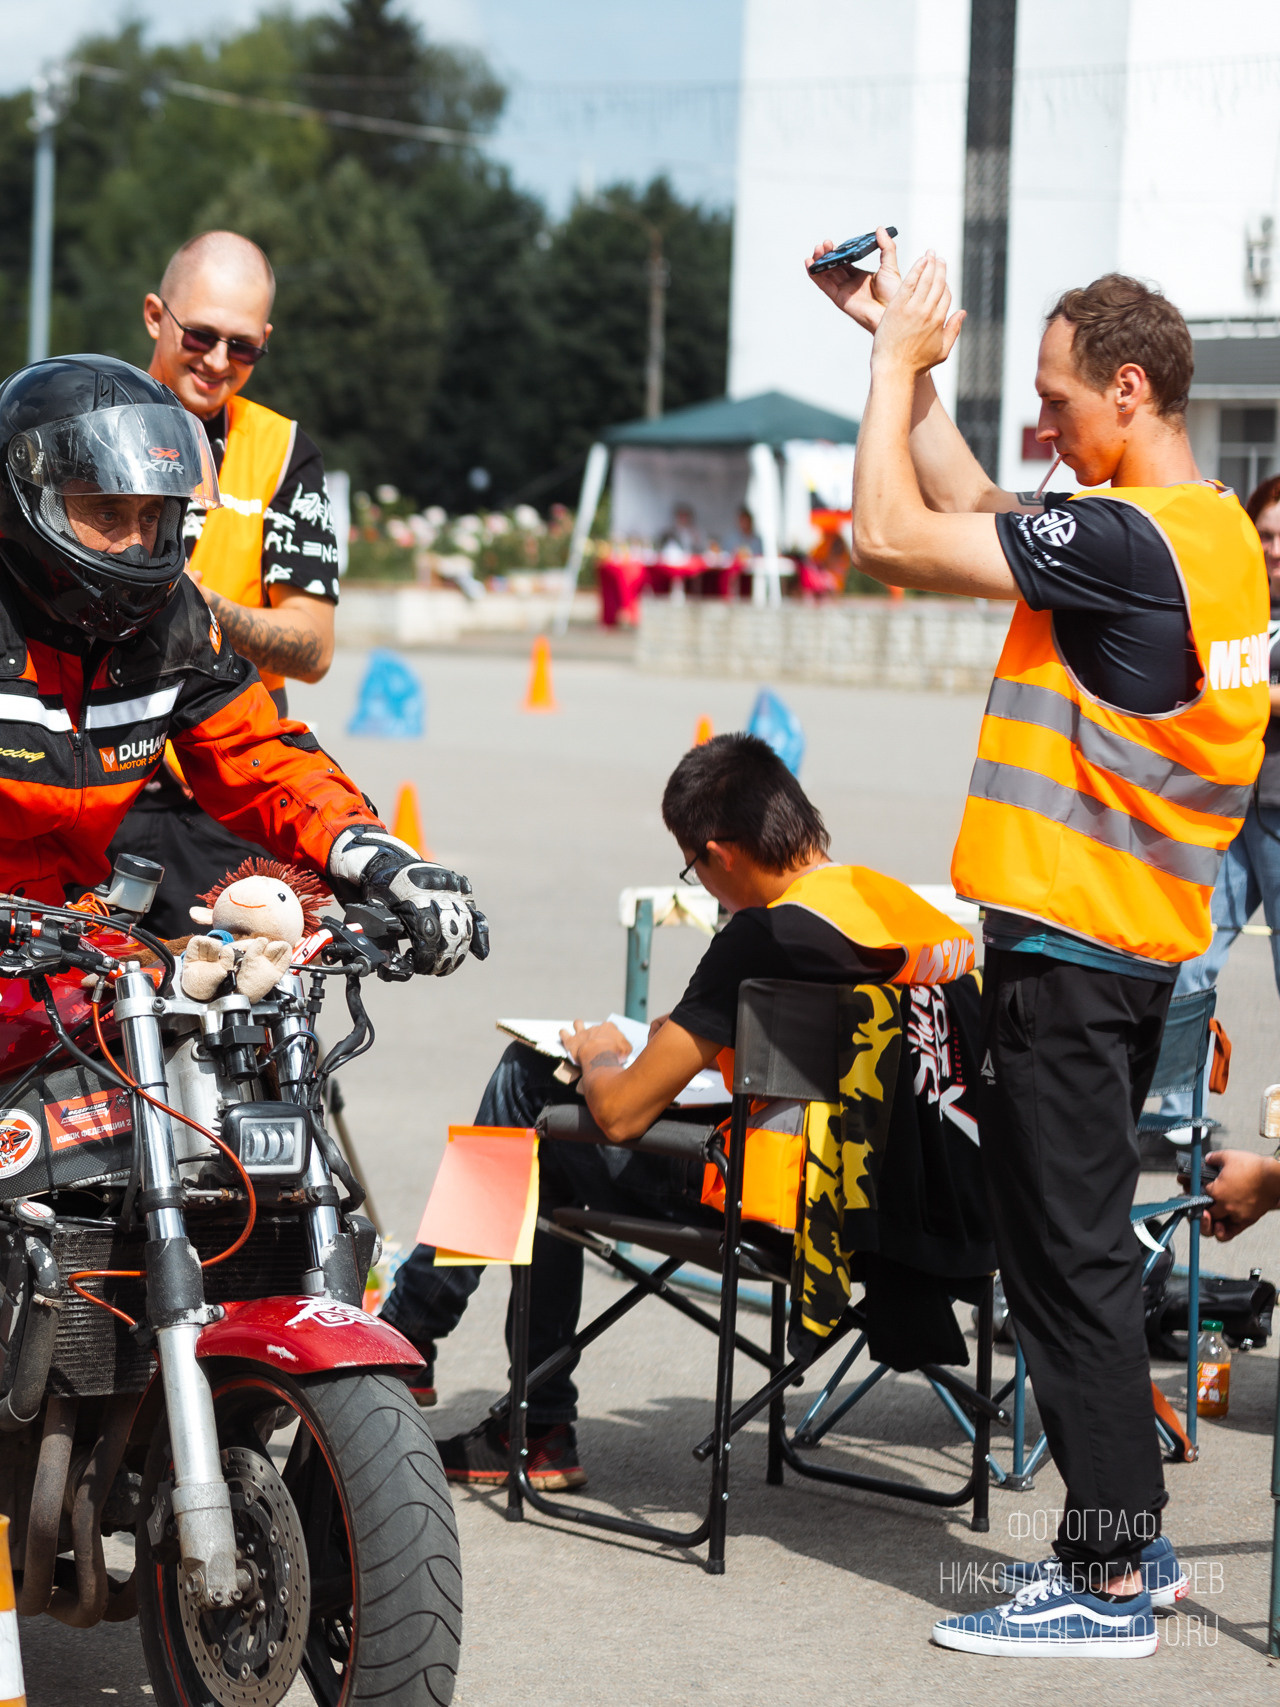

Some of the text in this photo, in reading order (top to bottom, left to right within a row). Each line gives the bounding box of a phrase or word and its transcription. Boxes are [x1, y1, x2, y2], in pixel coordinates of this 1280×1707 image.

[119, 730, 168, 762] DUHAN
[120, 757, 147, 772] MOTOR
[56, 1131, 80, 1144] КУБОК
[81, 1122, 126, 1138] ФЕДЕРАЦИИ
